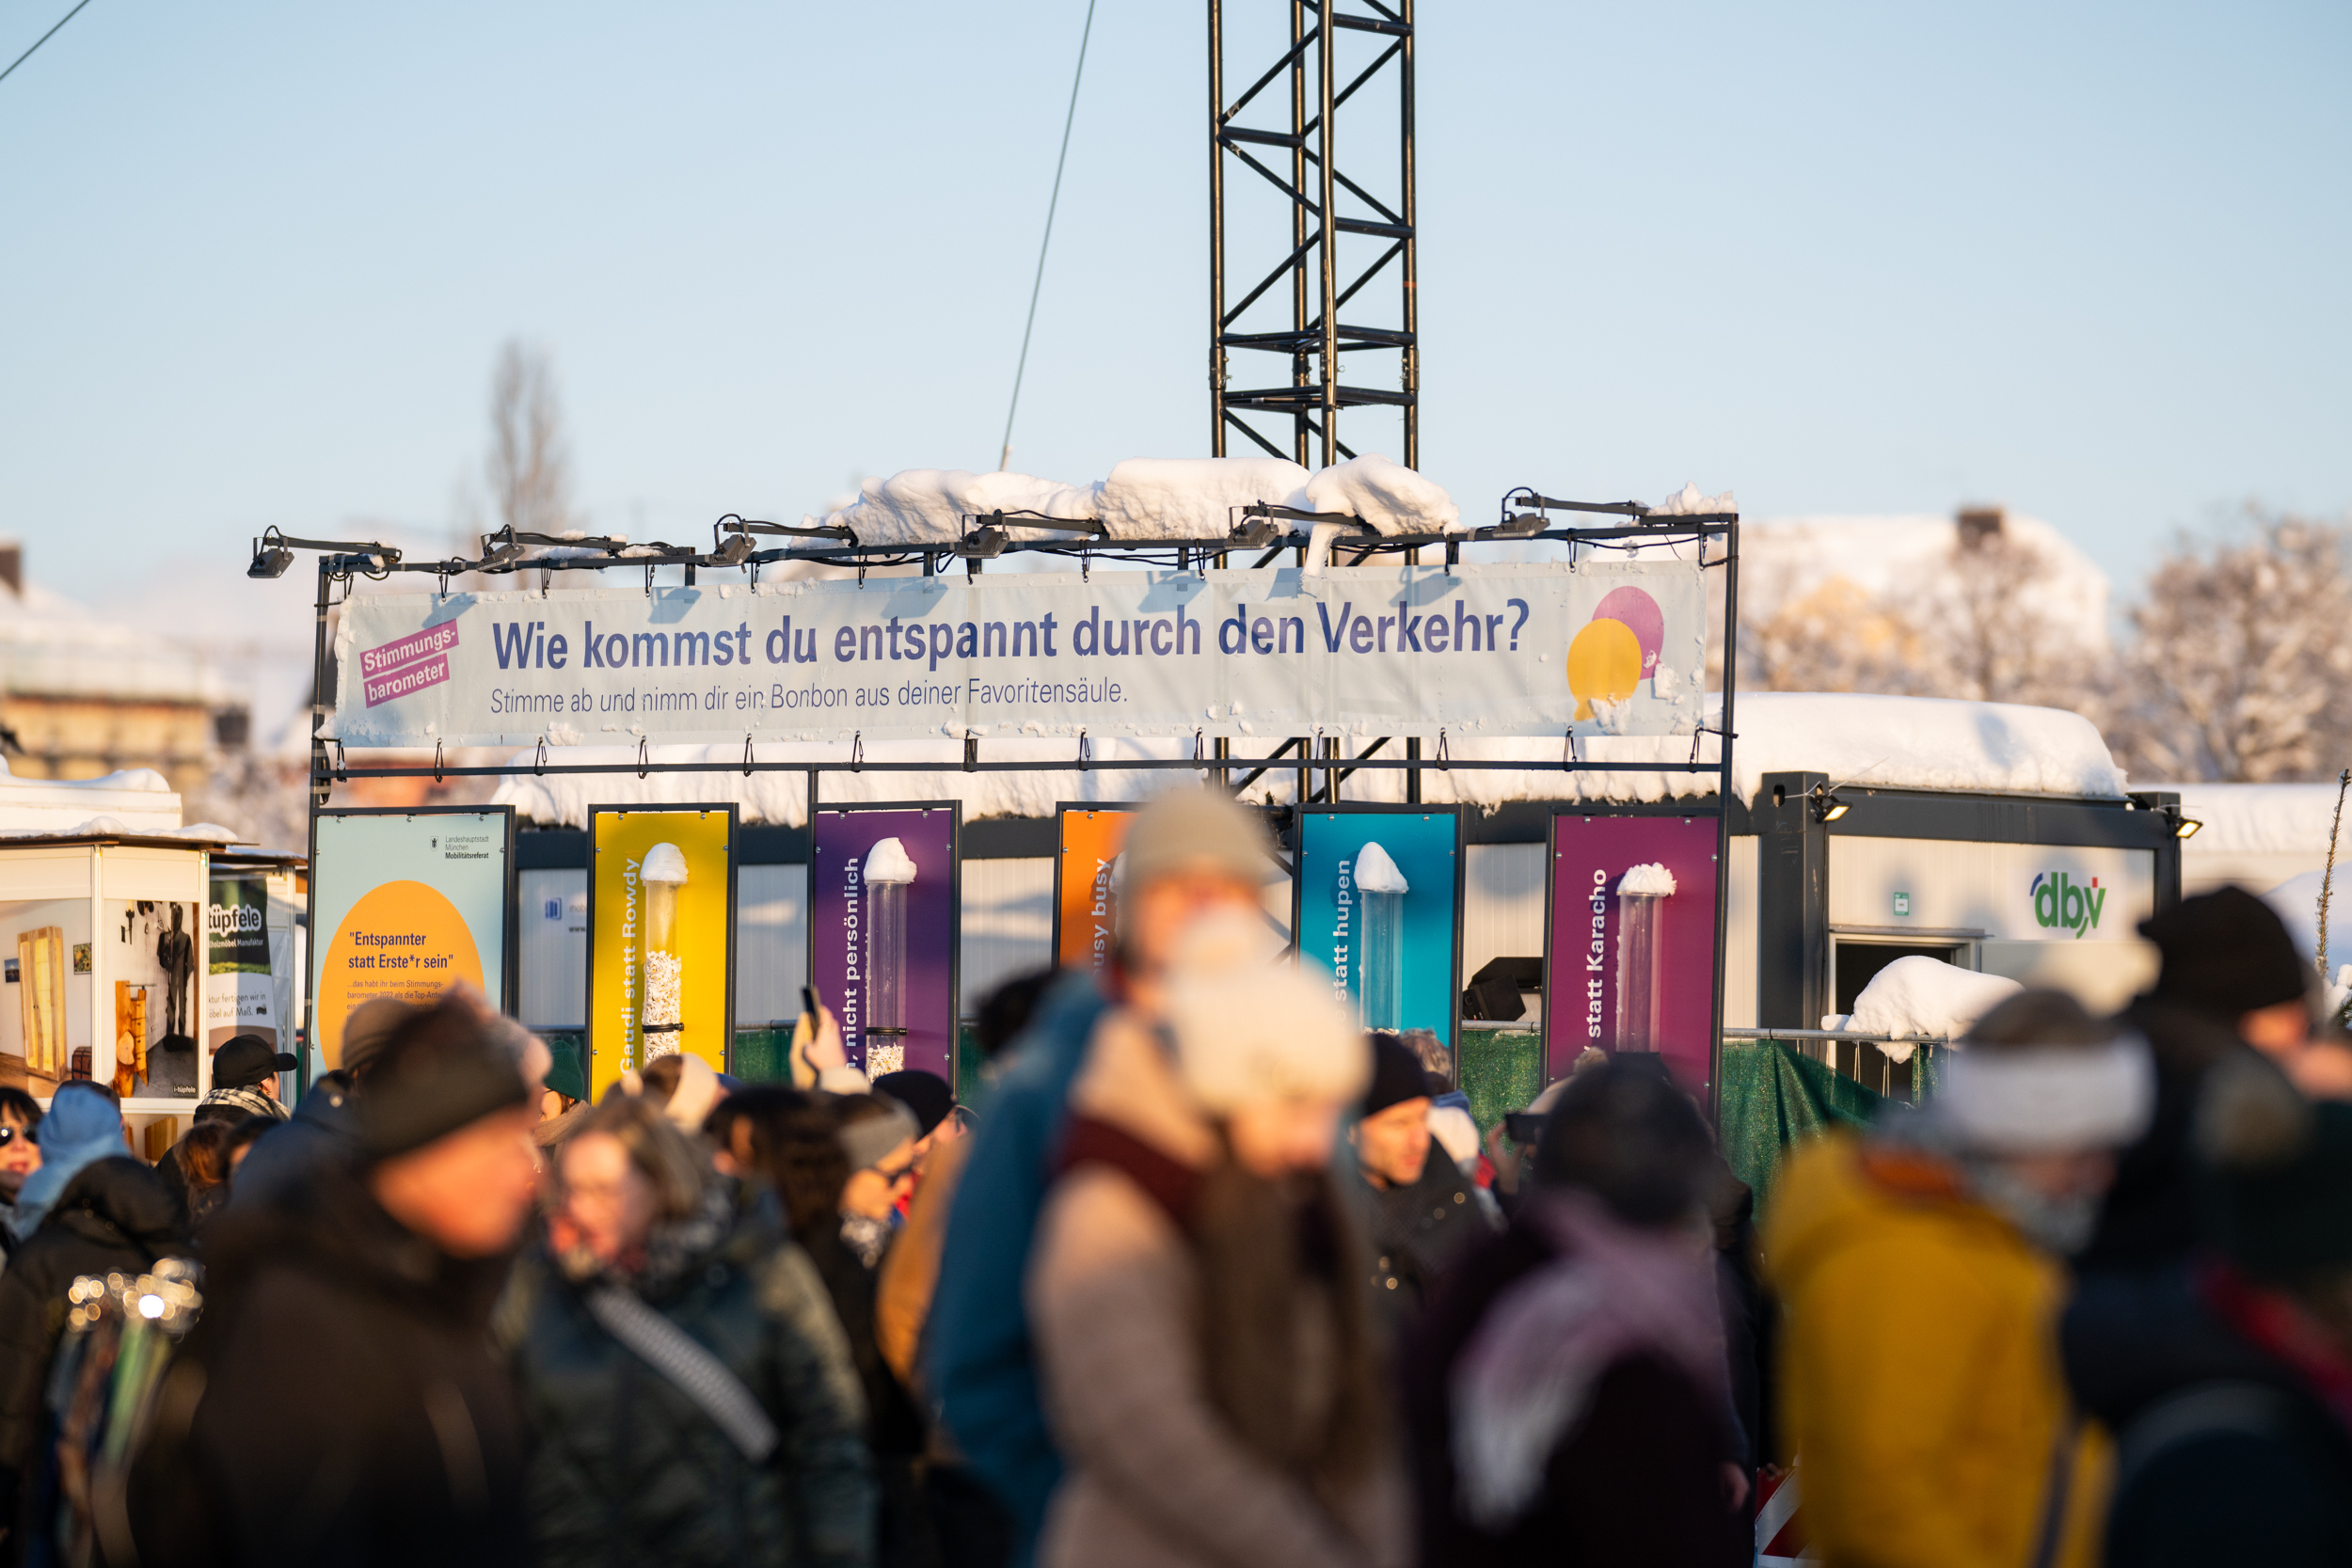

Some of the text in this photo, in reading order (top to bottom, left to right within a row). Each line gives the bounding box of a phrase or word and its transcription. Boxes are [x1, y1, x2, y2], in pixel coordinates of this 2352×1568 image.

[364, 628, 456, 673] Stimmungs-
[492, 597, 1530, 672] Wie kommst du entspannt durch den Verkehr?
[368, 660, 446, 703] barometer
[490, 675, 1128, 714] Stimme ab und nimm dir ein Bonbon aus deiner Favoritensäule.
[445, 843, 469, 851] München
[445, 851, 489, 860] Mobilitätsreferat
[1090, 857, 1112, 917] busy
[1332, 860, 1353, 937] hupen
[349, 931, 427, 949] "Entspannter
[843, 857, 861, 981] persönlich
[1585, 868, 1607, 972] Karacho
[348, 955, 375, 969] statt
[423, 954, 453, 968] sein"
[619, 857, 640, 1076] Gaudi statt Rowdy
[1332, 944, 1349, 1003] statt
[221, 992, 249, 1006] fertigen
[249, 991, 260, 1001] wir
[260, 990, 267, 1000] in
[346, 990, 442, 1000] barometer 2022 als die Top-Antw
[364, 979, 379, 988] habt
[379, 979, 389, 988] ihr
[389, 979, 405, 988] beim
[405, 979, 443, 990] Stimmungs-
[222, 1006, 234, 1018] auf
[235, 1006, 254, 1017] Maß.
[842, 987, 857, 1047] nicht
[1586, 978, 1603, 1038] statt
